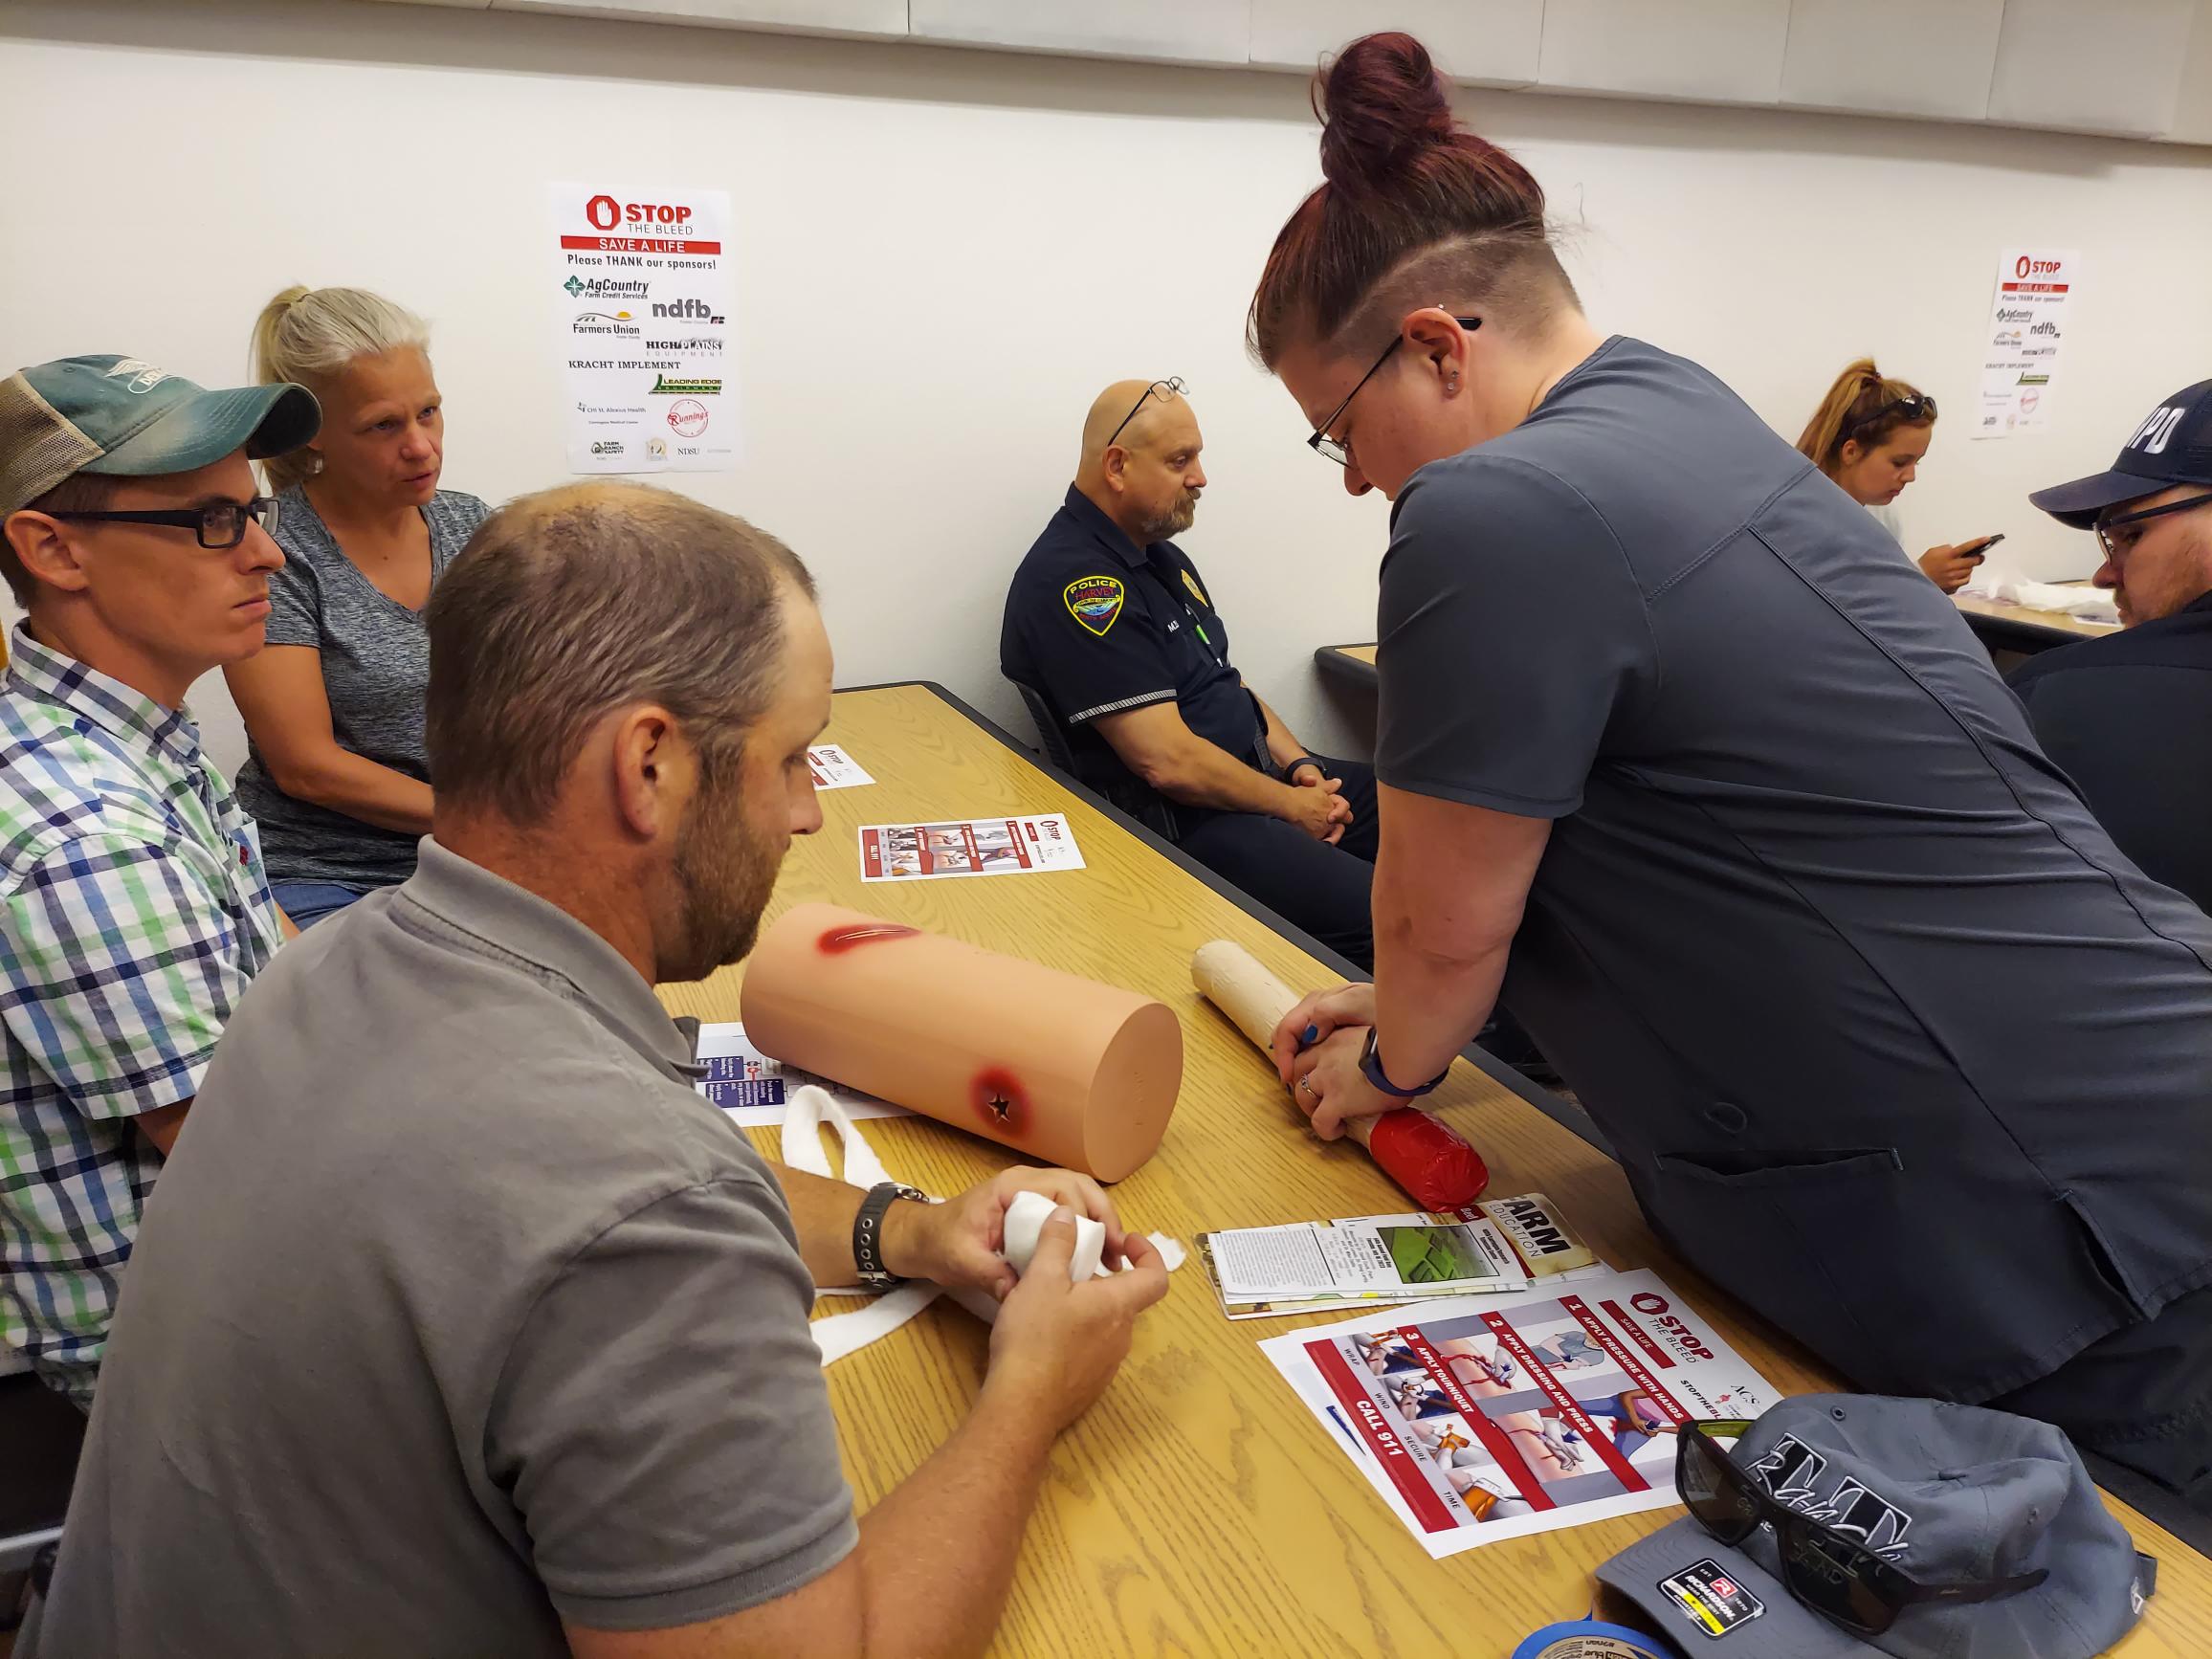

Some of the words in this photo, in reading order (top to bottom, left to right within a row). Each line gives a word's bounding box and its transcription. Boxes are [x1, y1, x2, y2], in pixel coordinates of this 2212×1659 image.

[626, 204, 692, 224] STOP
[627, 224, 651, 233] THE
[655, 225, 694, 235] BLEED
[599, 239, 635, 251] SAVE
[640, 240, 650, 251] A
[655, 241, 685, 253] LIFE
[567, 254, 602, 265] Please
[607, 256, 643, 267] THANK
[647, 259, 663, 268] our
[667, 259, 717, 271] sponsors!
[2032, 261, 2061, 273] STOP
[586, 278, 650, 295] AgCountry
[653, 299, 711, 319] ndfb
[573, 323, 612, 334] Farmers
[613, 324, 640, 335] Union
[2030, 322, 2056, 335] ndfb
[646, 341, 678, 349] HIGH
[568, 361, 614, 369] KRACHT
[618, 361, 680, 369] IMPLEMENT
[667, 411, 708, 426] Runnings
[1070, 580, 1117, 595] POLICE
[1048, 827, 1061, 840] STOP
[1489, 1204, 1541, 1257] EDUCATION
[1502, 1195, 1571, 1254] ARM
[1621, 1317, 1637, 1334] SAVE
[1637, 1337, 1653, 1349] LIFE
[1648, 1318, 1670, 1335] THE
[1666, 1336, 1697, 1363] BLEED
[1659, 1316, 1714, 1360] STOP
[1344, 1348, 1360, 1365] WRAP
[1582, 1316, 1607, 1338] APPLY
[1604, 1337, 1640, 1375] PRESSURE
[1637, 1374, 1658, 1393] WITH
[1654, 1391, 1684, 1420] HANDS
[1417, 1347, 1438, 1371] APPLY
[1434, 1368, 1473, 1413] TOURNIQUET
[1502, 1334, 1524, 1358] APPLY
[1522, 1355, 1556, 1391] DRESSING
[1552, 1390, 1571, 1408] AND
[1567, 1407, 1593, 1433] PRESS
[1374, 1392, 1390, 1409] WIND
[1681, 1380, 1722, 1419] STOPTHEBL
[1357, 1401, 1383, 1430] CALL
[1378, 1432, 1404, 1456] 911
[1404, 1436, 1427, 1461] SECURE
[1443, 1492, 1460, 1509] TIME
[1685, 1575, 1736, 1619] RICHARDSON
[1699, 1595, 1709, 1604] THE
